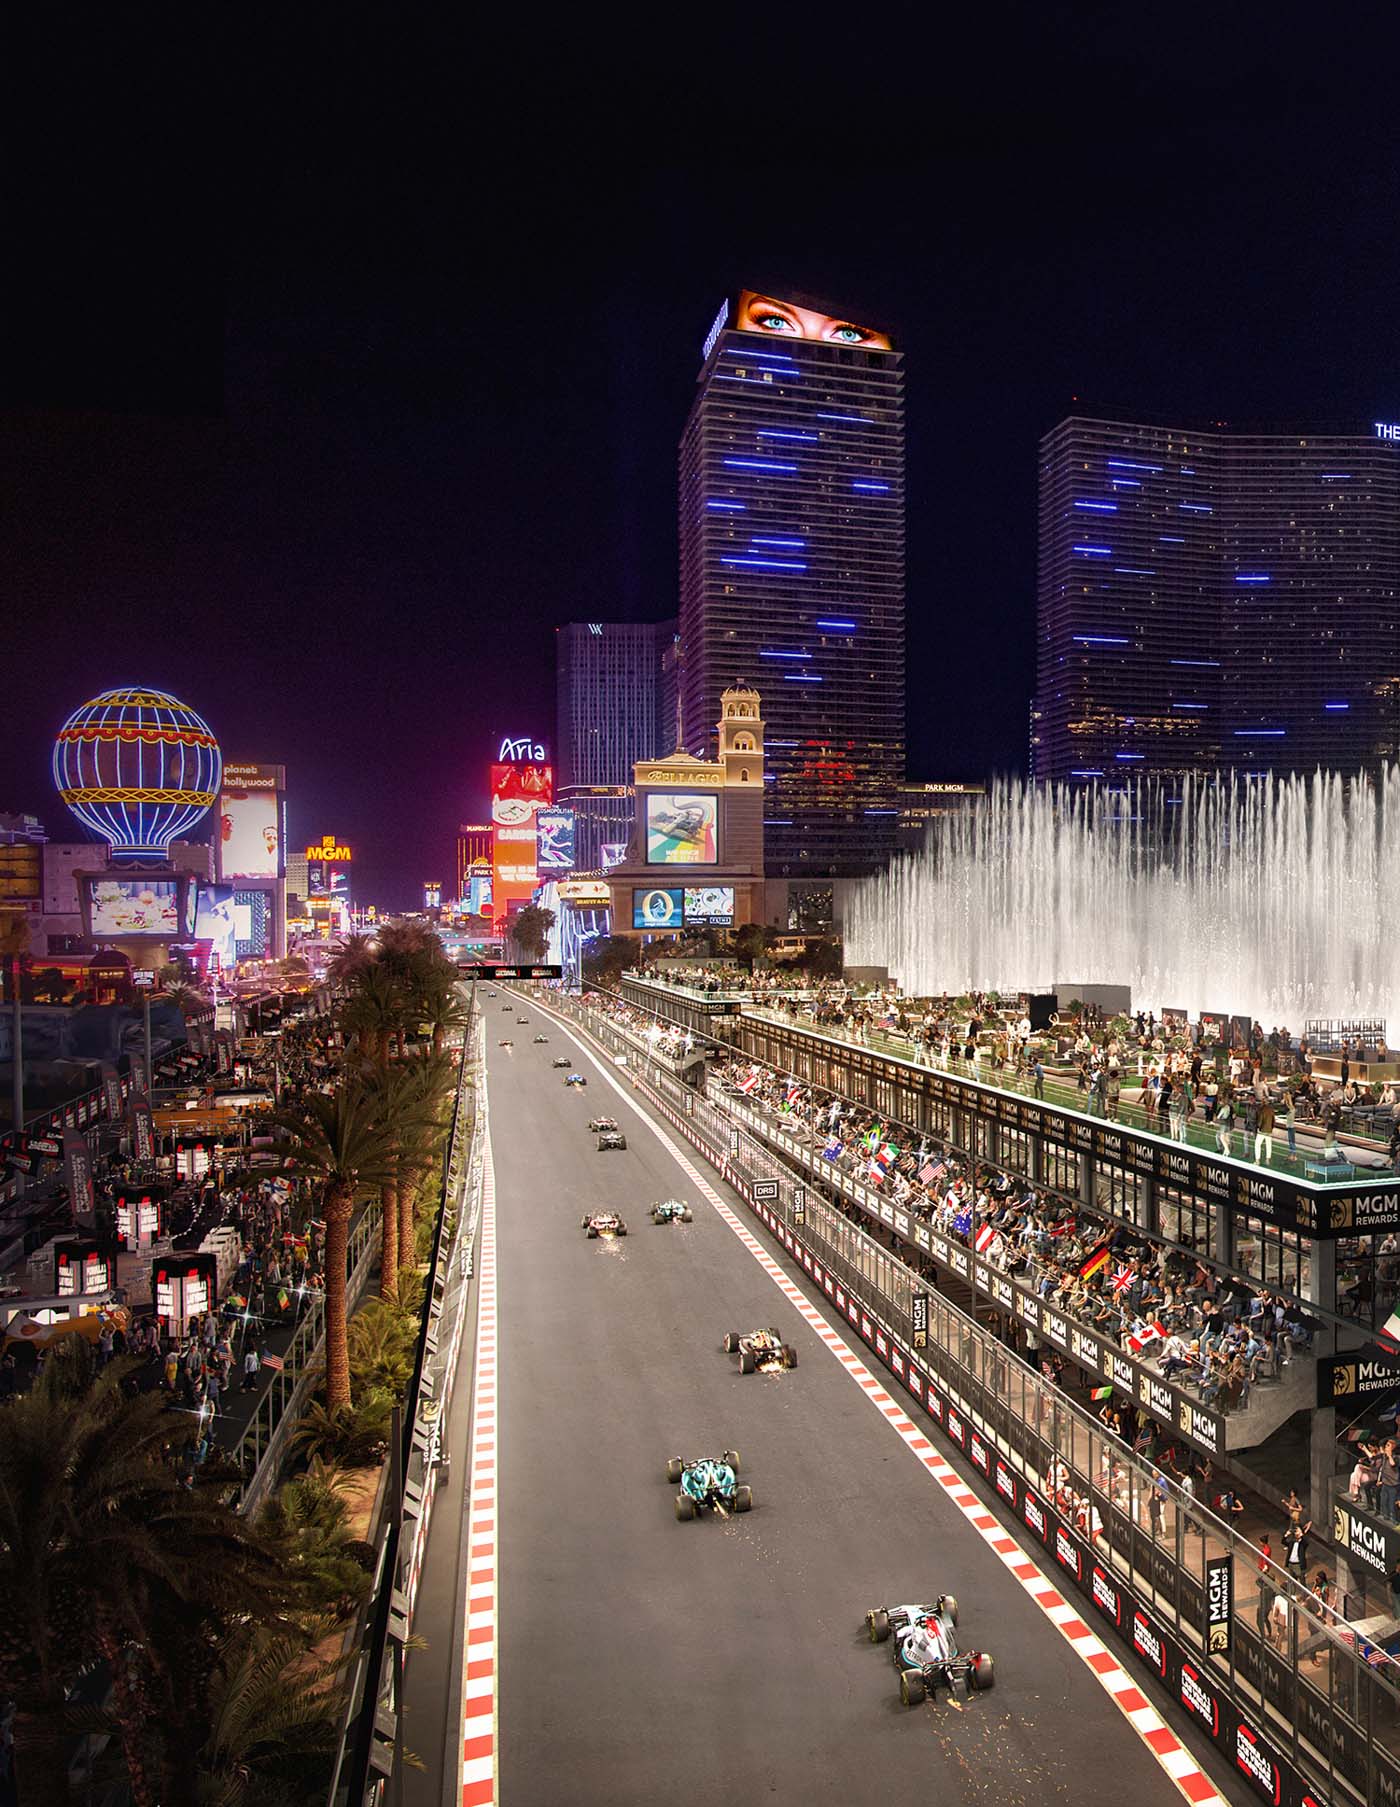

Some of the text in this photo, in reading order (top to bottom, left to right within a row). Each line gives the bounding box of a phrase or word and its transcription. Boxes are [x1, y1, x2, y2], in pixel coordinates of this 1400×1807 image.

[1375, 423, 1400, 440] THE
[499, 738, 545, 762] Aria
[224, 764, 257, 776] planet
[648, 771, 720, 783] BELLAGIO
[224, 777, 274, 788] hollywood
[307, 848, 351, 860] MGM
[1077, 1124, 1092, 1139] MGM
[1106, 1134, 1121, 1150] MGM
[1136, 1144, 1154, 1160] MGM
[1170, 1155, 1189, 1174] MGM
[1170, 1170, 1190, 1184] REWARDS
[1208, 1166, 1229, 1186] MGM
[758, 1186, 774, 1195] DRS
[1208, 1184, 1230, 1198] REWARDS
[1250, 1180, 1274, 1201] MGM
[1250, 1198, 1274, 1214] REWARDS
[1356, 1194, 1398, 1214] MGM
[1356, 1214, 1398, 1226] REWARDS
[914, 1300, 922, 1330] MGM
[1051, 1314, 1066, 1338] MGM
[1081, 1334, 1098, 1360] MGM
[1114, 1357, 1132, 1383] MGM
[1359, 1362, 1400, 1380] MG
[1359, 1378, 1400, 1392] REWARDS
[1151, 1381, 1172, 1410] MGM
[1193, 1410, 1216, 1440] MGM
[1193, 1430, 1217, 1454] REWARDS
[1351, 1516, 1386, 1559] MGM
[1351, 1540, 1386, 1573] REWARDS
[1210, 1568, 1221, 1621] MGM
